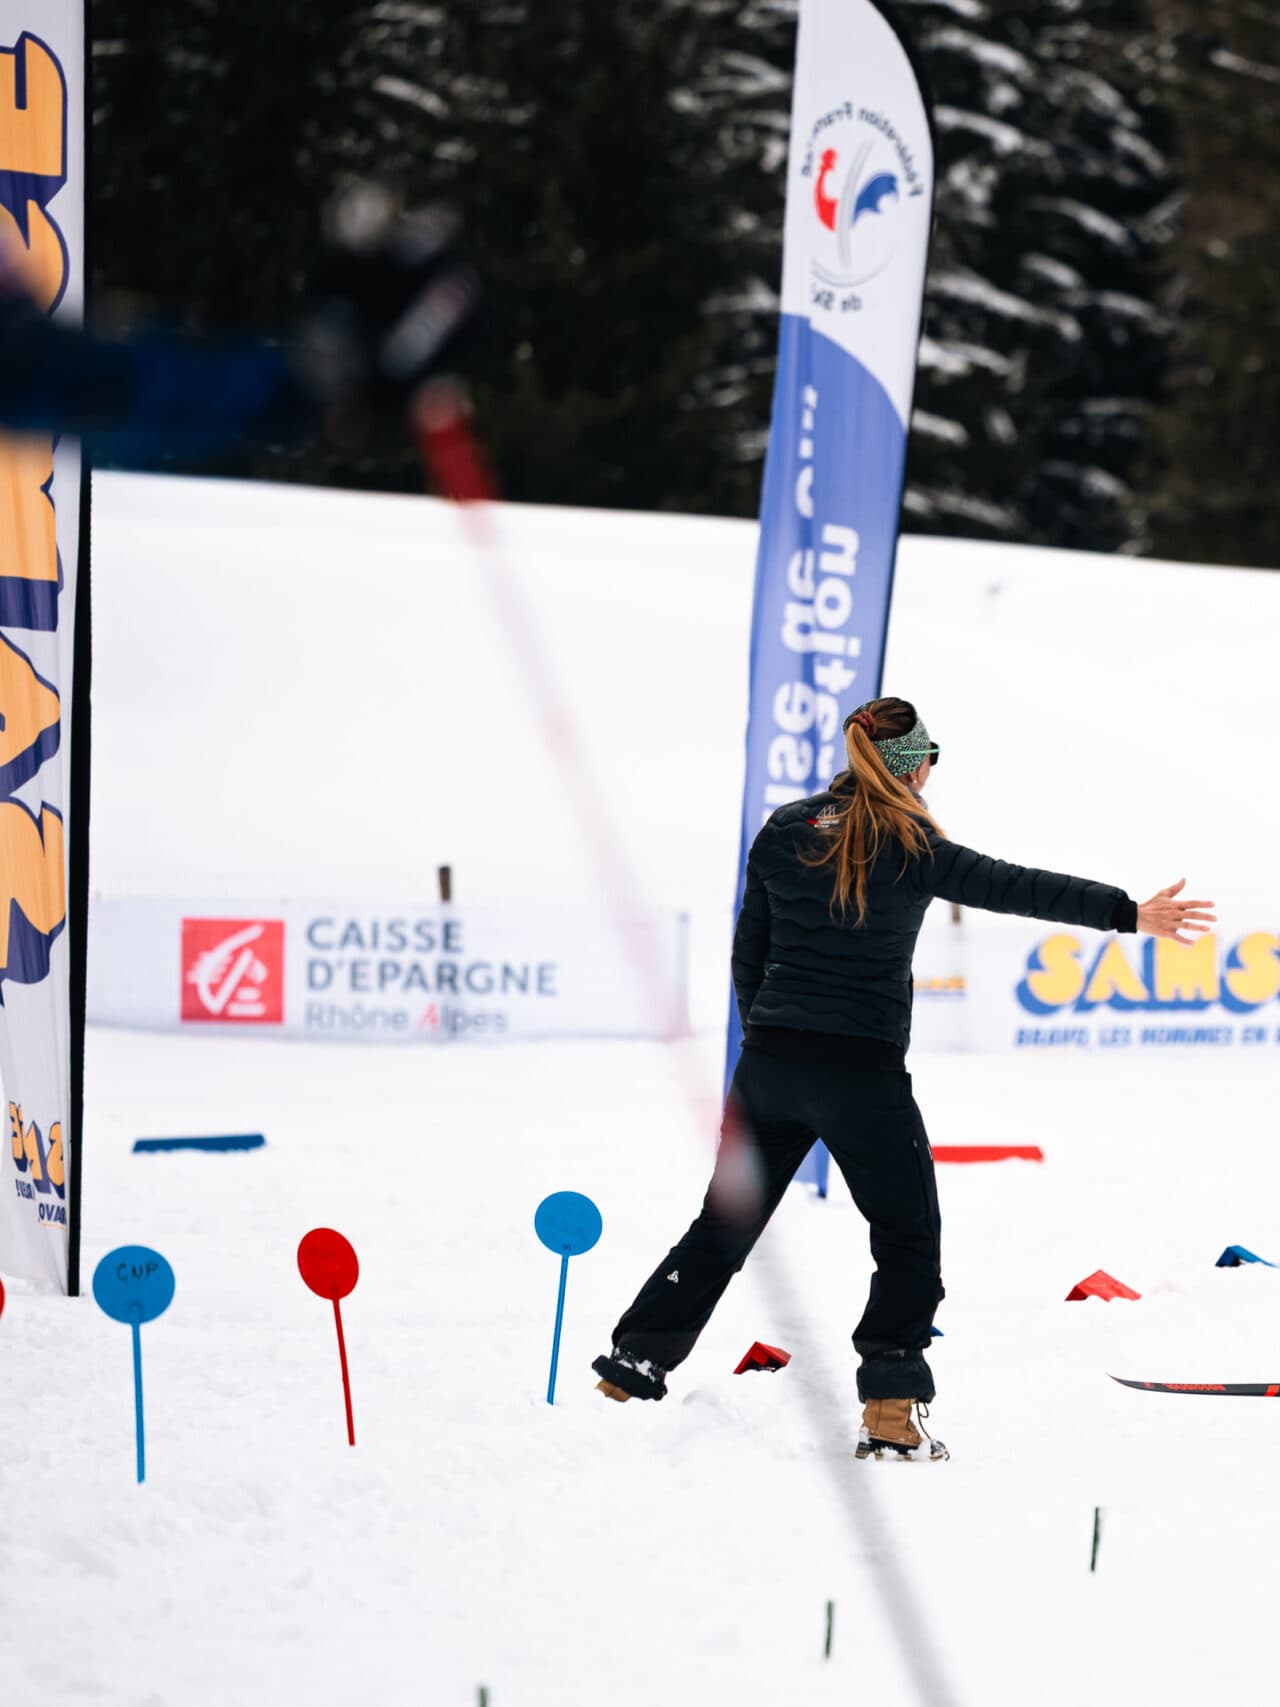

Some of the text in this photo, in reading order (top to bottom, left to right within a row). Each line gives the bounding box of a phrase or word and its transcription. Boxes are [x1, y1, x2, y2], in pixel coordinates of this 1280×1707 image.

[305, 916, 465, 954] CAISSE
[306, 958, 559, 997] D'EPARGNE
[304, 1002, 509, 1035] Rhône Alpes
